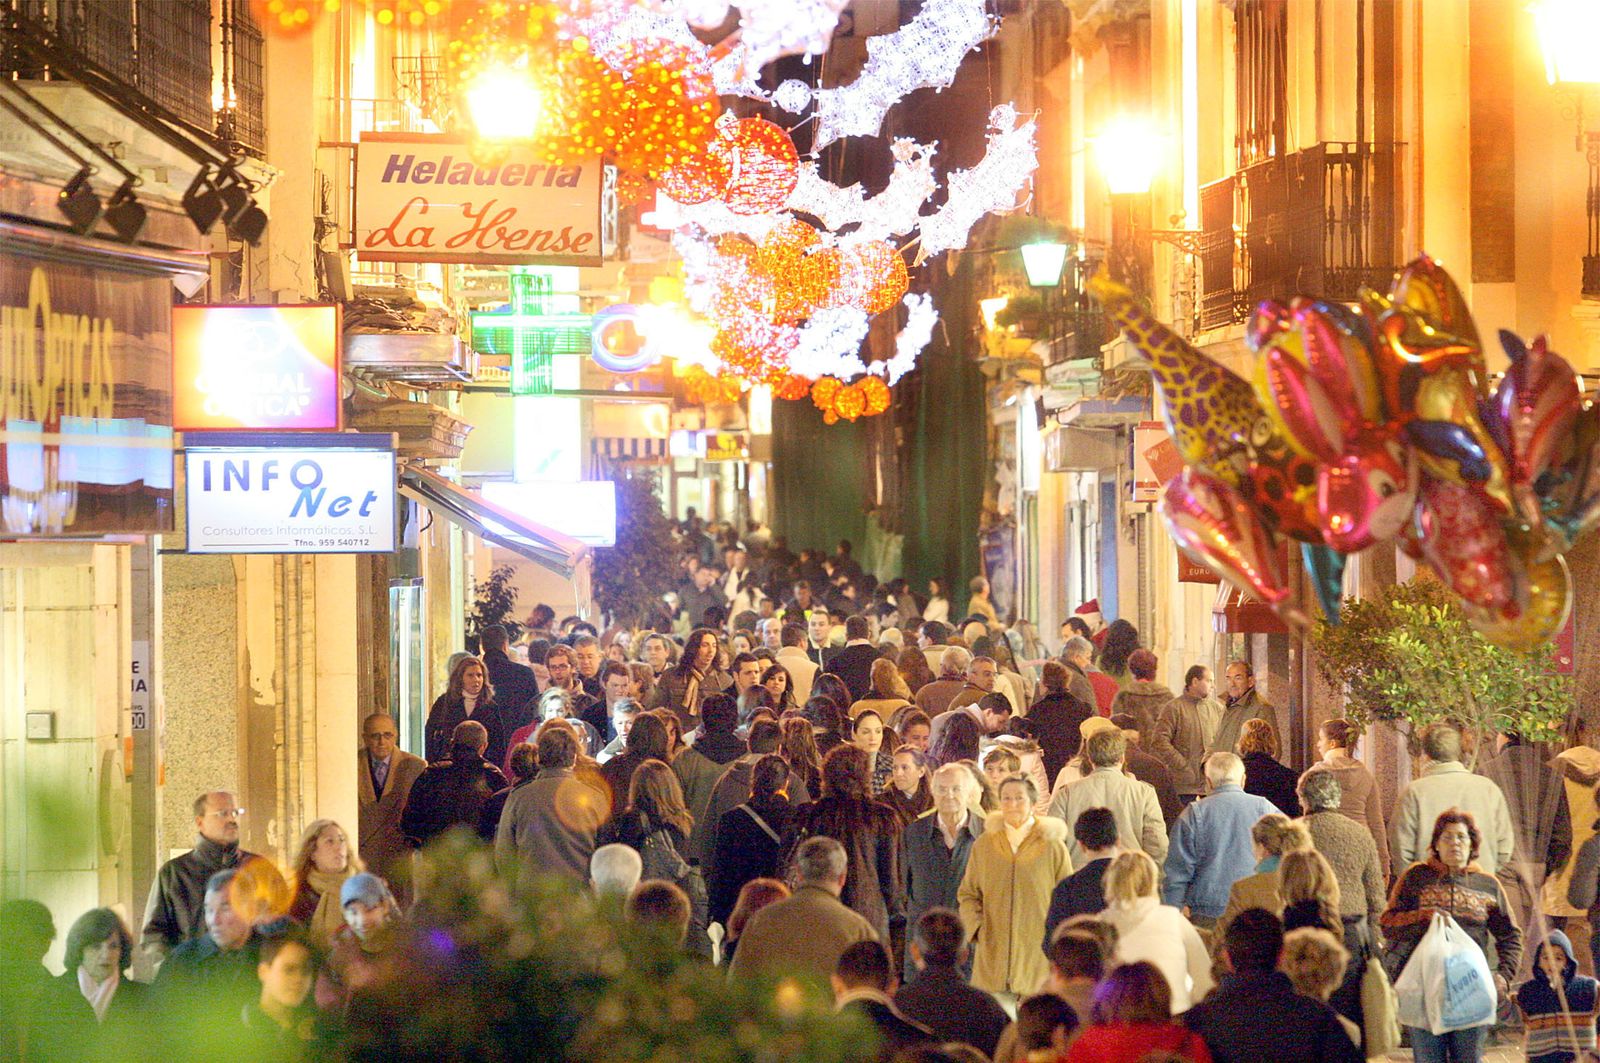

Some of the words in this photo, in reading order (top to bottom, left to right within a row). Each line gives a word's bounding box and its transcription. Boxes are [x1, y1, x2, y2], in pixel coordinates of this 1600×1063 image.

[364, 196, 436, 248] La
[203, 459, 323, 491] INFO
[289, 487, 378, 518] Net
[202, 526, 274, 537] Consultores
